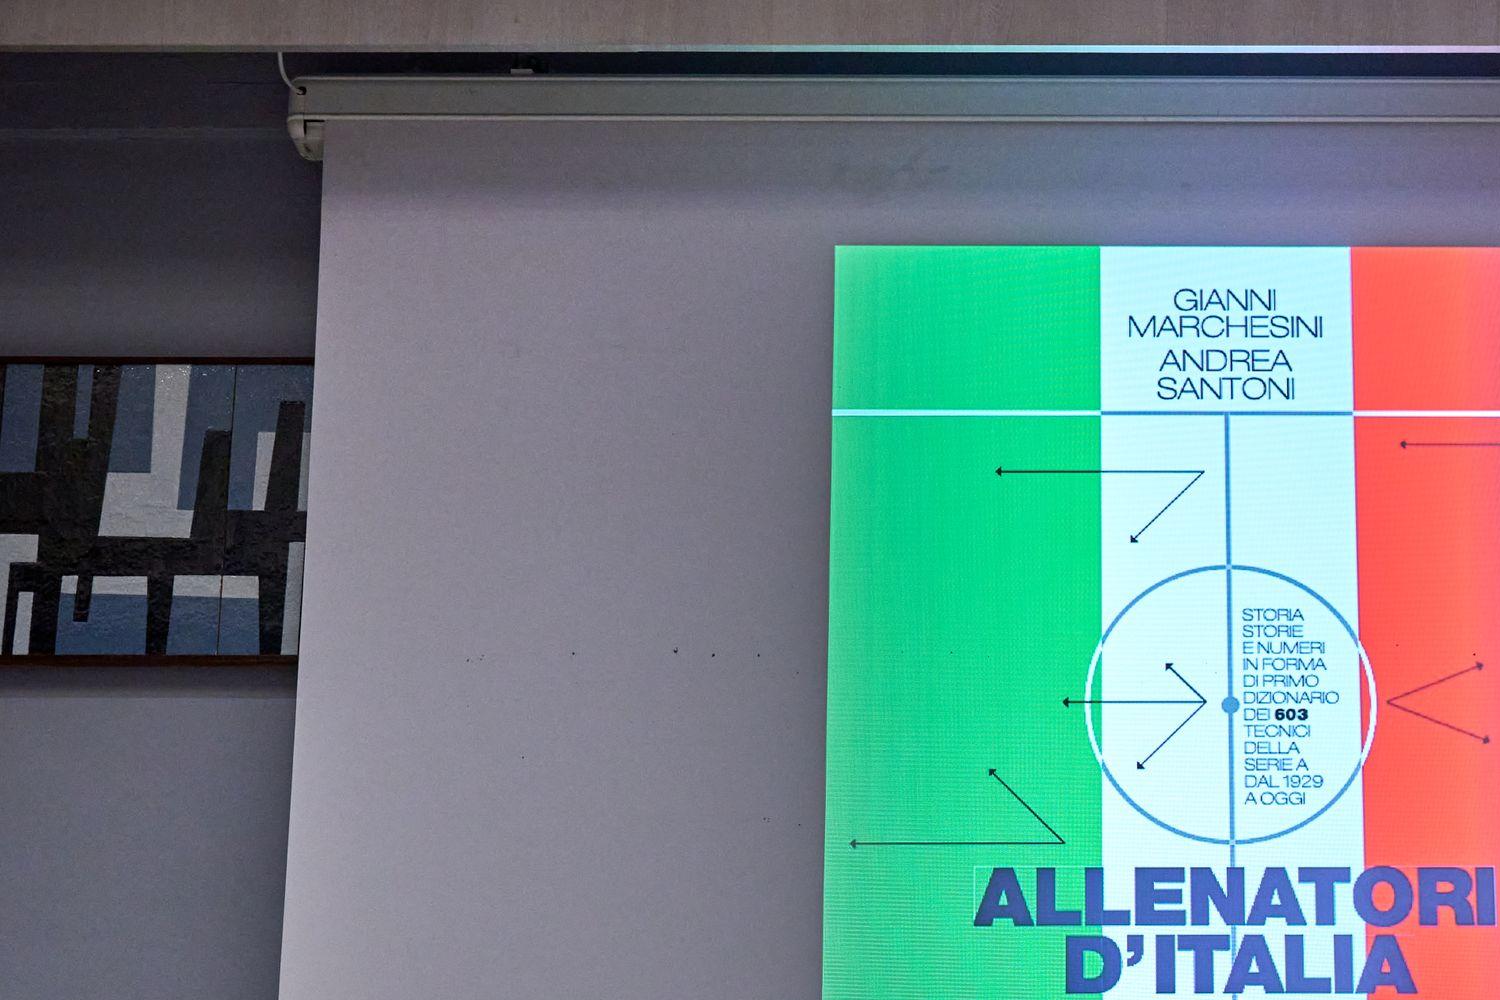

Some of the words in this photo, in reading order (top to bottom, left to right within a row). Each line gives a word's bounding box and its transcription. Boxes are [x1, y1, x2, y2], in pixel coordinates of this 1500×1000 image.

[1174, 289, 1276, 311] GIANNI
[1128, 315, 1323, 338] MARCHESINI
[1159, 350, 1292, 372] ANDREA
[1157, 377, 1294, 400] SANTONI
[1242, 608, 1304, 621] STORIA
[1243, 625, 1303, 638] STORIE
[1243, 642, 1254, 654] E
[1257, 642, 1325, 654] NUMERI
[1243, 658, 1258, 670] IN
[1263, 658, 1327, 670] FORMA
[1243, 675, 1258, 687] DI
[1263, 675, 1319, 687] PRIMO
[1244, 692, 1339, 704] DIZIONARIO
[1244, 708, 1270, 721] DEI
[1275, 708, 1308, 721] 603
[1244, 725, 1310, 737] TECNICI
[1245, 741, 1300, 754] DELLA
[1245, 758, 1292, 771] SERIE
[1296, 758, 1309, 771] A
[1245, 775, 1279, 788] DAL
[1284, 775, 1324, 788] 1929
[1245, 792, 1257, 805] A
[1261, 792, 1305, 805] OGGI
[974, 865, 1496, 927] ALLENATORI
[1065, 933, 1418, 994] D'ITALIA
